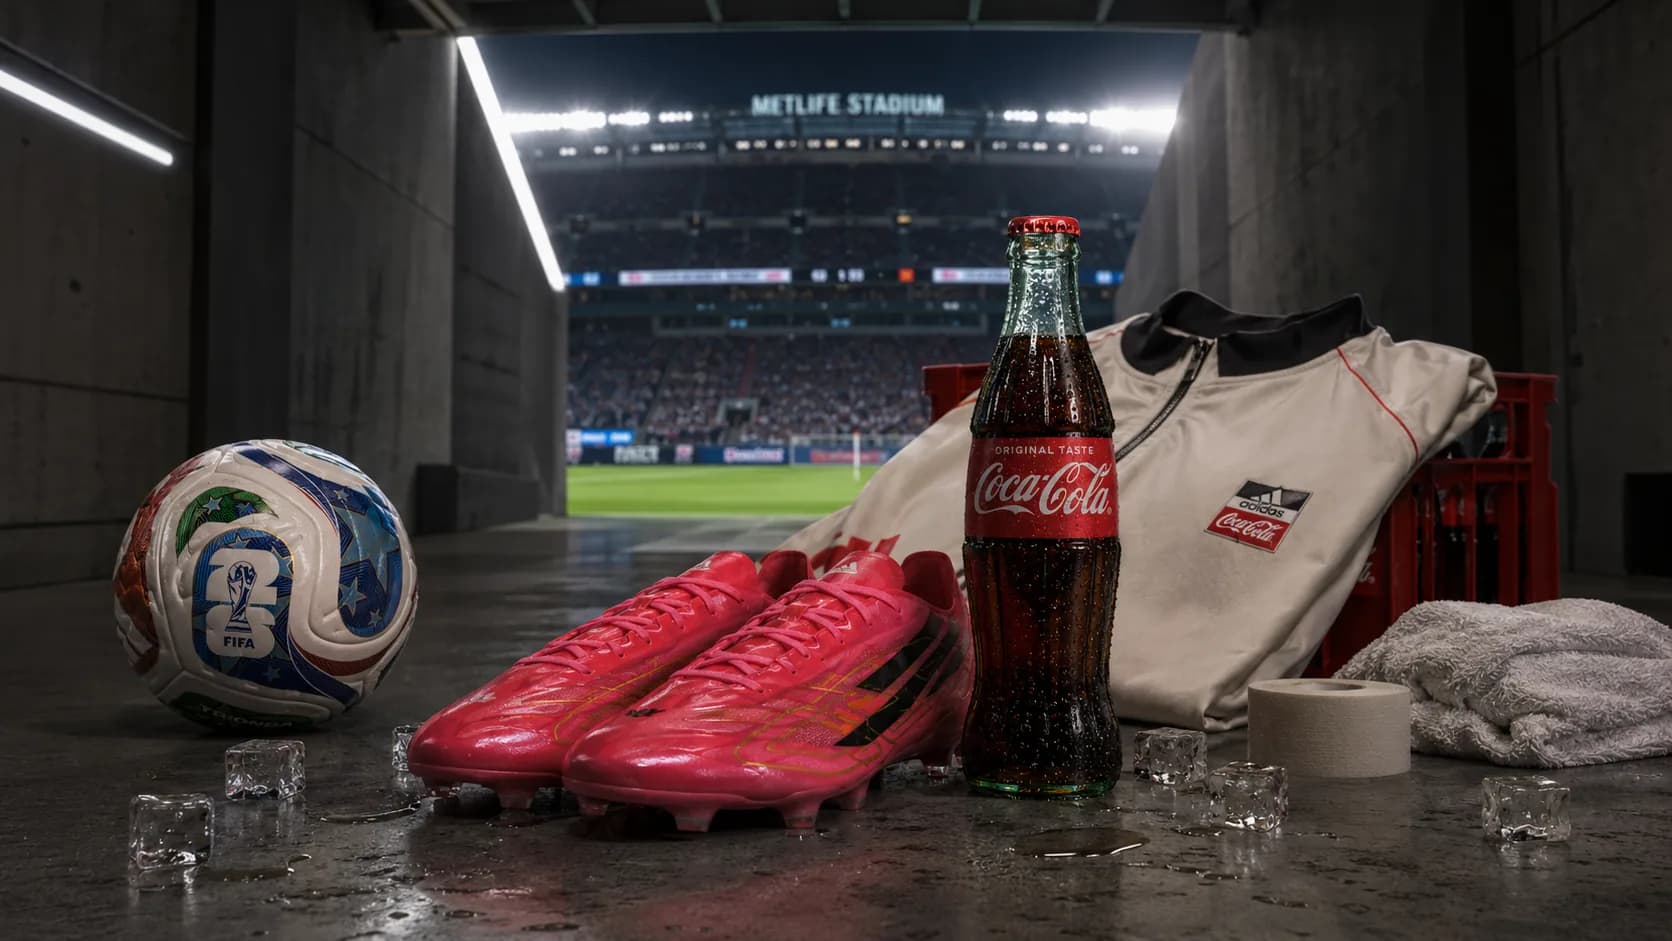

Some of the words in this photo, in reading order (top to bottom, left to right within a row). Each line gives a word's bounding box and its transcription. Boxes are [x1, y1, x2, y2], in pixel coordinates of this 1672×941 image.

[751, 93, 840, 116] METLIFE
[847, 92, 945, 115] STADIUM
[995, 446, 1054, 455] ORIGINAL
[1059, 446, 1095, 455] TASTE
[974, 462, 1112, 516] Coca-Cola
[1239, 500, 1285, 518] adidas
[223, 636, 255, 649] FIFA
